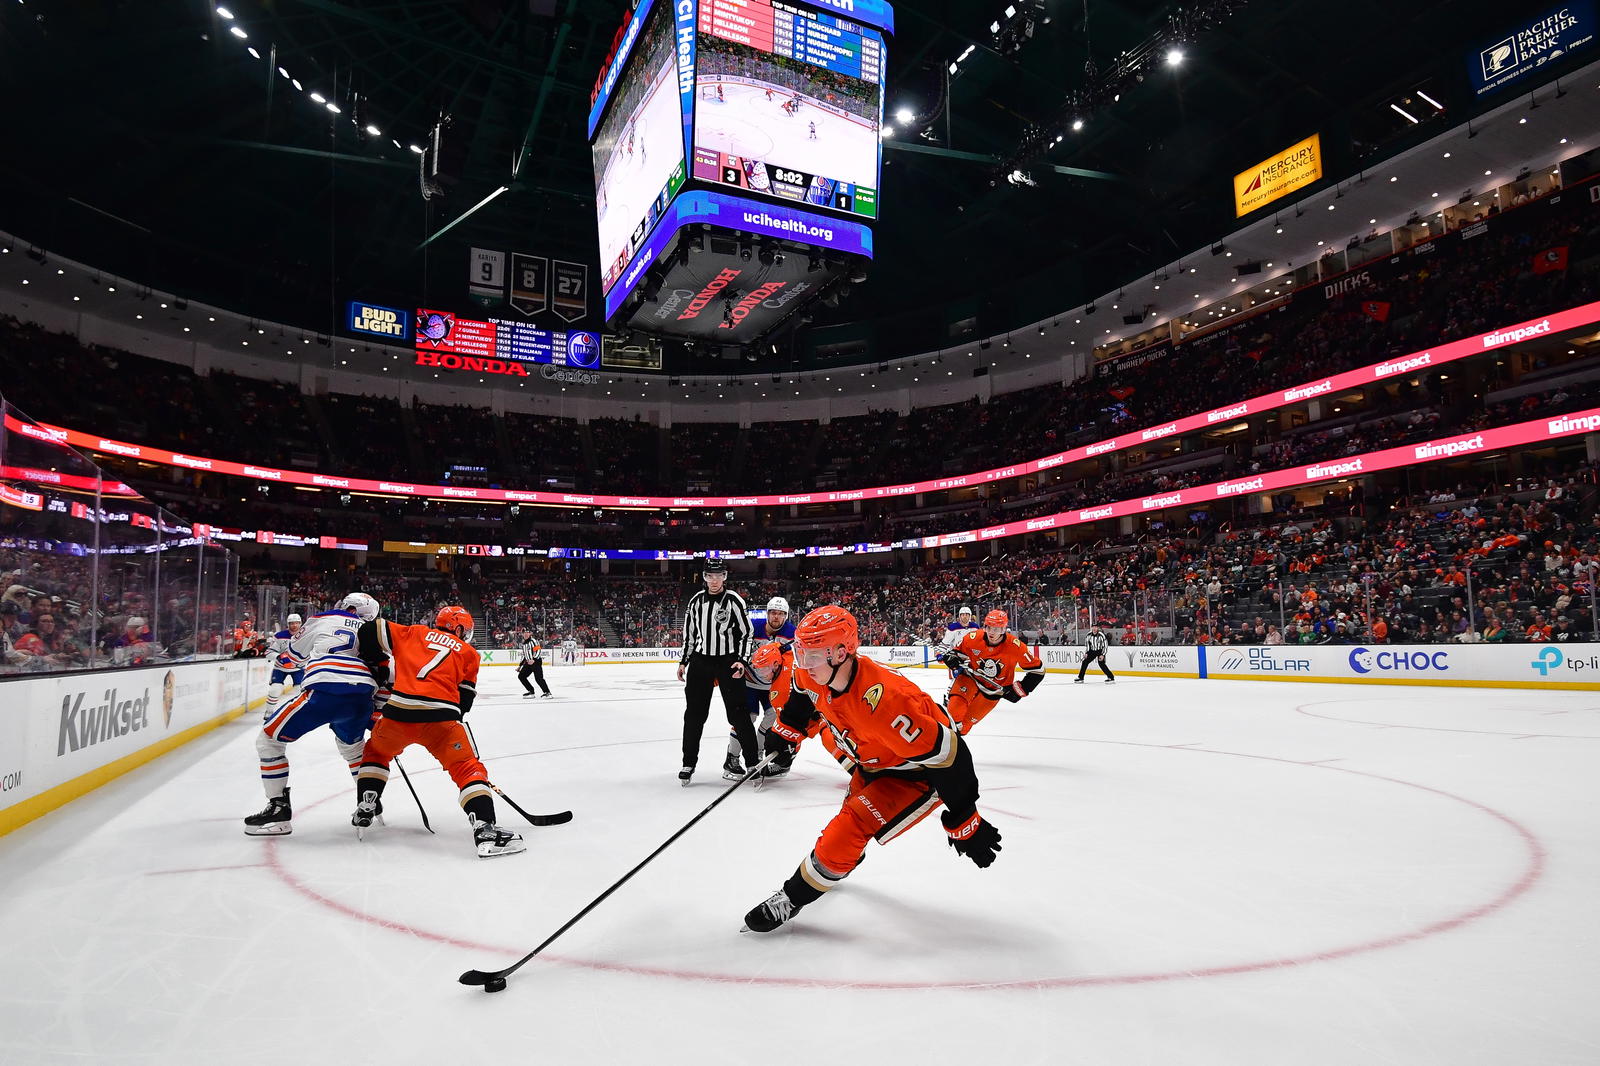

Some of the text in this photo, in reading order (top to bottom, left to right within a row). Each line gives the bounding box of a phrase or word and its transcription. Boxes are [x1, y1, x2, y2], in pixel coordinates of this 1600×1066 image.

[772, 0, 783, 9] TOP
[783, 4, 797, 14] TIME
[797, 9, 807, 17] ON
[800, 18, 842, 37] 2 BOUCHARD
[1517, 8, 1569, 42] PACIFIC
[807, 30, 828, 42] NURSE
[1519, 16, 1579, 51] PREMIER
[807, 47, 837, 61] WALMAN
[1520, 35, 1560, 61] BANK
[678, 25, 695, 93] Health
[807, 55, 828, 67] KULAK
[1262, 144, 1314, 178] MERCURY
[727, 170, 736, 182] 3
[775, 167, 803, 185] 8:02
[1262, 153, 1316, 186] INSURANCE
[841, 197, 846, 208] 1
[743, 212, 833, 241] ucihealth.org
[482, 262, 492, 281] 9
[523, 270, 535, 288] 8
[559, 276, 583, 295] 27
[676, 267, 743, 320] HONDA
[1325, 271, 1370, 300] DUCKS
[361, 306, 397, 323] BUD
[354, 317, 402, 335] LIGHT
[462, 321, 487, 329] LACOMBE
[1495, 319, 1550, 344] impact
[461, 348, 489, 356] CARLSSON
[415, 351, 529, 377] HONDA
[1117, 357, 1146, 373] ANAHEIM
[1386, 353, 1431, 375] impact
[540, 364, 600, 384] Center
[1293, 380, 1331, 399] impact
[1214, 404, 1247, 420] impact
[1149, 423, 1176, 438] impact
[106, 442, 140, 456] impact
[1093, 441, 1116, 454] impact
[1427, 435, 1483, 456] impact
[179, 456, 211, 469] impact
[1043, 455, 1063, 467] impact
[1315, 459, 1362, 477] impact
[254, 468, 281, 479] impact
[321, 477, 349, 487] impact
[389, 484, 415, 493] impact
[886, 485, 916, 495] impact
[1225, 477, 1263, 494] impact
[450, 489, 477, 497] impact
[512, 492, 537, 500] impact
[571, 495, 594, 504] impact
[733, 497, 758, 505] impact
[786, 495, 811, 503] impact
[837, 491, 864, 500] impact
[1149, 493, 1181, 508] impact
[679, 498, 704, 506] impact
[1086, 507, 1113, 519] impact
[1033, 518, 1055, 528] impact
[987, 527, 1006, 537] impact
[329, 630, 357, 653] 2
[425, 631, 463, 653] GUDAS
[416, 643, 451, 680] 7
[1047, 650, 1072, 663] ASYLUM
[1249, 648, 1271, 659] OC
[1377, 651, 1449, 671] CHOC
[1250, 659, 1311, 672] SOLAR
[1567, 656, 1600, 672] tp-li
[57, 687, 149, 757] Kwikset
[891, 715, 923, 743] 2
[2, 770, 22, 792] COM
